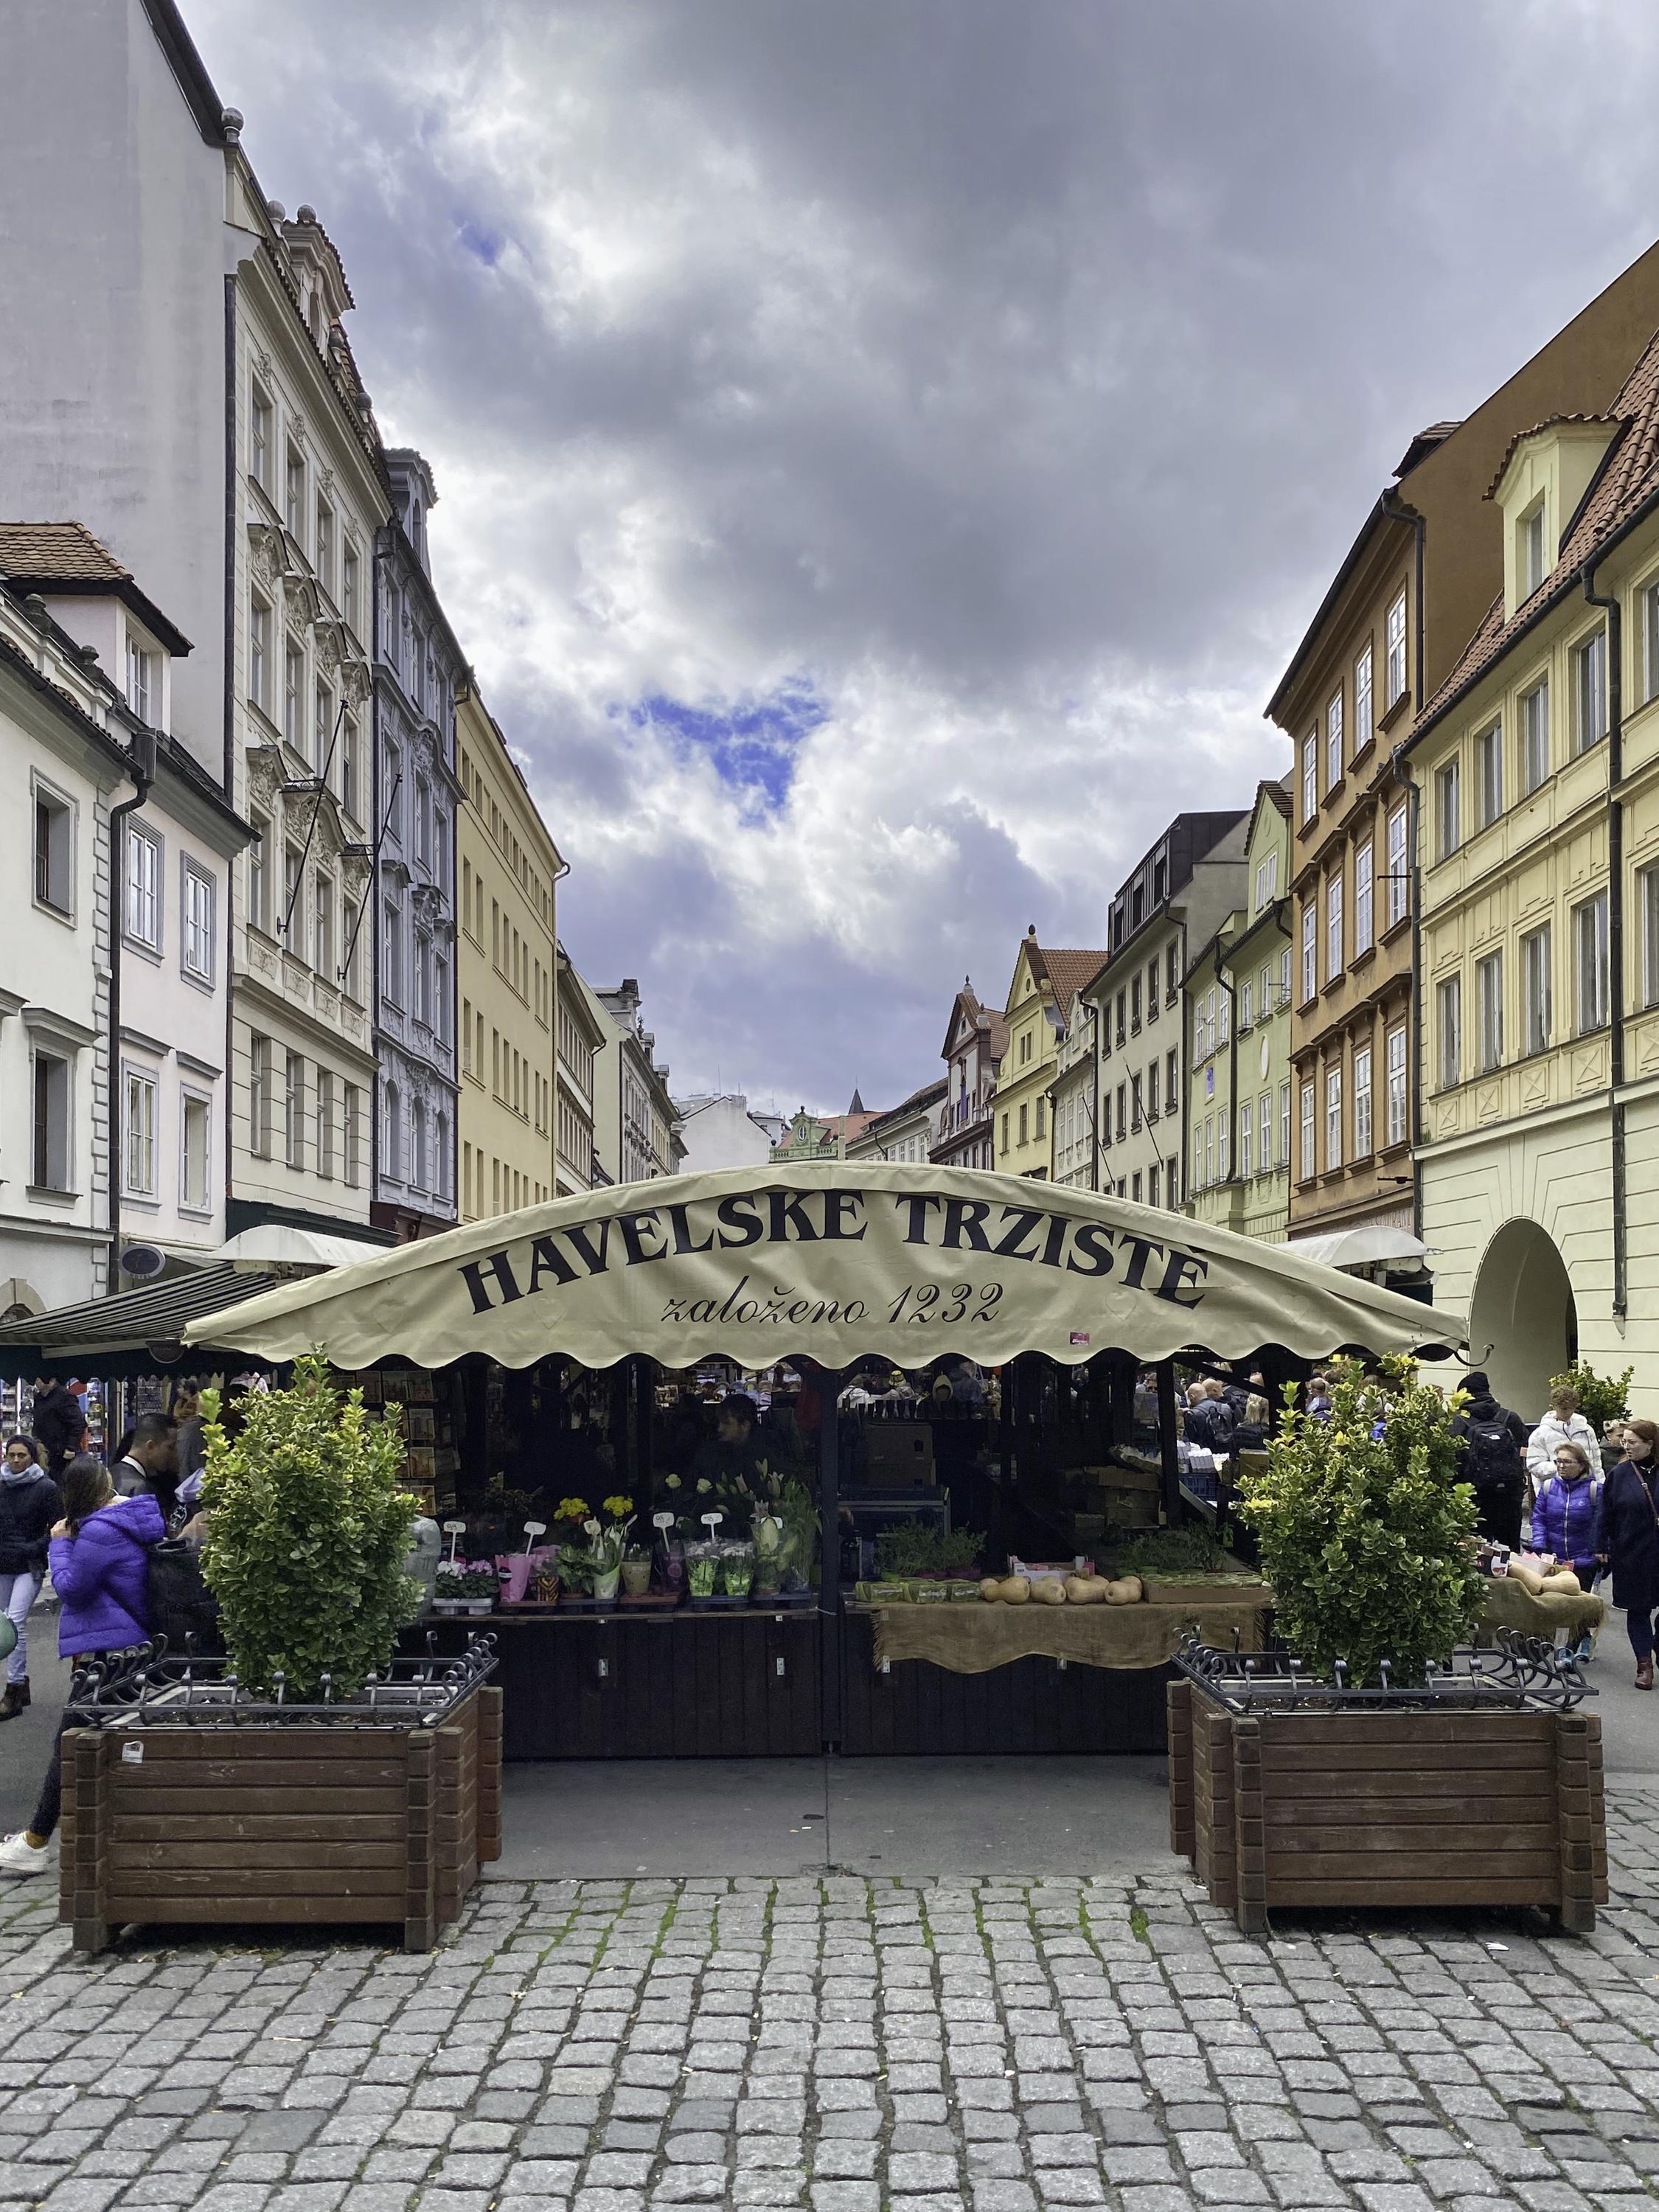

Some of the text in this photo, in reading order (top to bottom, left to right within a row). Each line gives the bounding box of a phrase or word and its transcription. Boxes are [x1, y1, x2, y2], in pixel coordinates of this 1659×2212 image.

[456, 1189, 868, 1315] HAVELSKE
[660, 1275, 1004, 1324] založeno 1232
